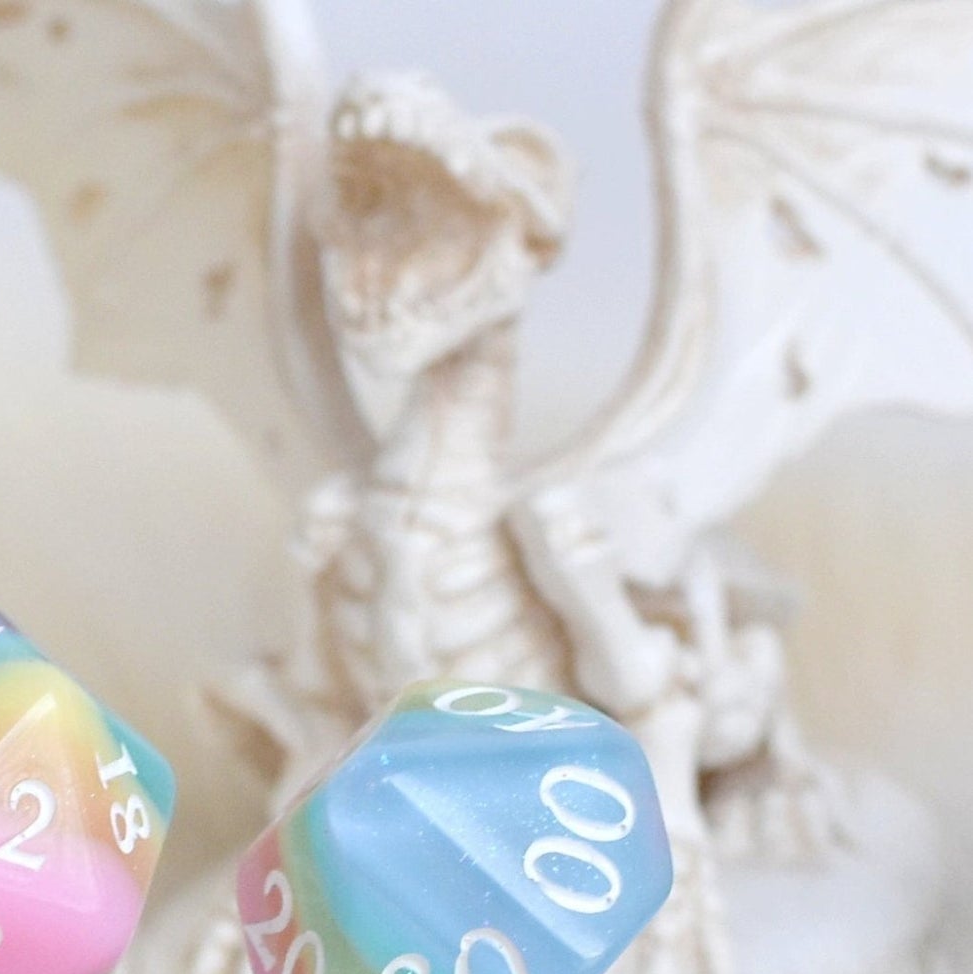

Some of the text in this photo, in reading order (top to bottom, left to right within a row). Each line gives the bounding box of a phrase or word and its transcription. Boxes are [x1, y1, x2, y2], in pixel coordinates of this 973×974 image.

[433, 686, 599, 733] 40
[94, 743, 153, 854] 18
[523, 764, 636, 914] 00
